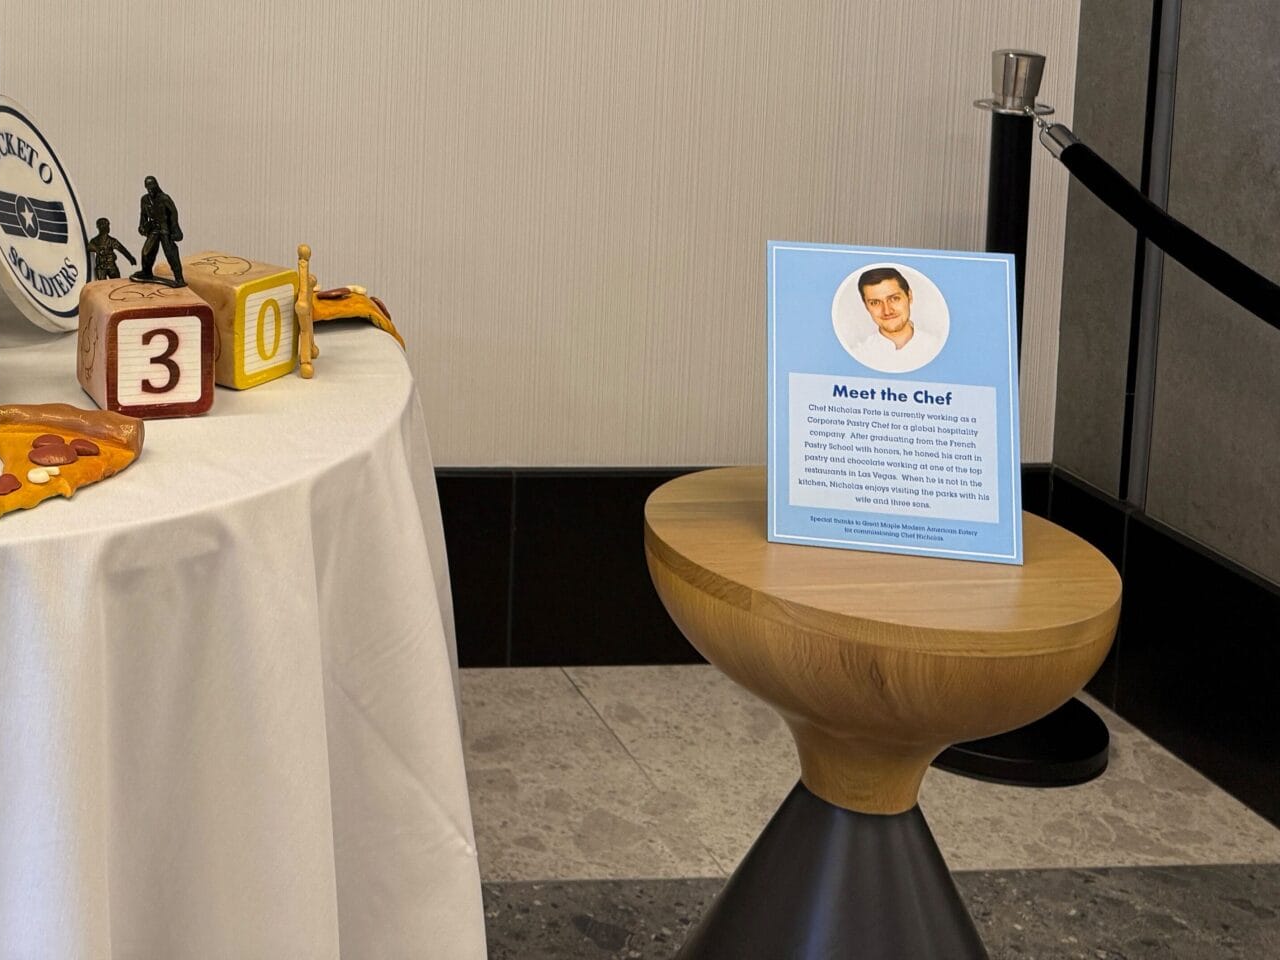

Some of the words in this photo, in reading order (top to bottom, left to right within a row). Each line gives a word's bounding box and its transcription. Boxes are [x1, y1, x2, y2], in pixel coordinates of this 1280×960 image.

[38, 162, 53, 184] O
[8, 246, 79, 298] SOLDIERS
[140, 328, 181, 394] 3
[832, 384, 876, 400] Meet
[880, 387, 908, 402] the
[913, 390, 952, 405] Chef
[808, 404, 826, 412] Chef
[828, 405, 861, 414] Nicholas
[891, 411, 926, 420] currently
[927, 413, 959, 423] working
[807, 416, 845, 426] Corporate
[846, 419, 870, 429] Pastry
[871, 421, 889, 429] Chef
[890, 422, 901, 430] for
[910, 425, 935, 433] global
[937, 427, 979, 437] hospitality
[850, 432, 869, 440] After
[870, 434, 914, 445] graduating
[916, 438, 933, 446] from
[935, 438, 948, 447] the
[949, 440, 976, 449] French
[804, 441, 827, 450] Pastry
[828, 442, 854, 452] School
[855, 445, 872, 453] with
[903, 448, 913, 456] he
[914, 450, 939, 459] honed
[941, 451, 953, 460] his
[954, 453, 973, 461] craft
[974, 454, 982, 462] in
[804, 454, 828, 463] pastry
[829, 456, 846, 464] and
[847, 457, 885, 466] chocolate
[886, 461, 918, 470] working
[955, 466, 968, 474] the
[969, 467, 982, 475] top
[804, 467, 847, 476] restaurants
[848, 469, 856, 477] in
[857, 470, 871, 478] Las
[901, 474, 925, 483] When
[926, 476, 936, 484] he
[945, 478, 958, 486] not
[960, 479, 968, 487] in
[969, 480, 983, 488] the
[829, 480, 864, 490] Nicholas
[865, 484, 890, 493] enjoys
[891, 486, 920, 496] visiting
[921, 488, 934, 496] the
[935, 490, 958, 498] parks
[959, 492, 976, 500] with
[978, 493, 990, 501] his
[855, 496, 872, 504] wife
[890, 498, 911, 507] three
[810, 515, 833, 523] Special
[901, 531, 915, 539] Chef
